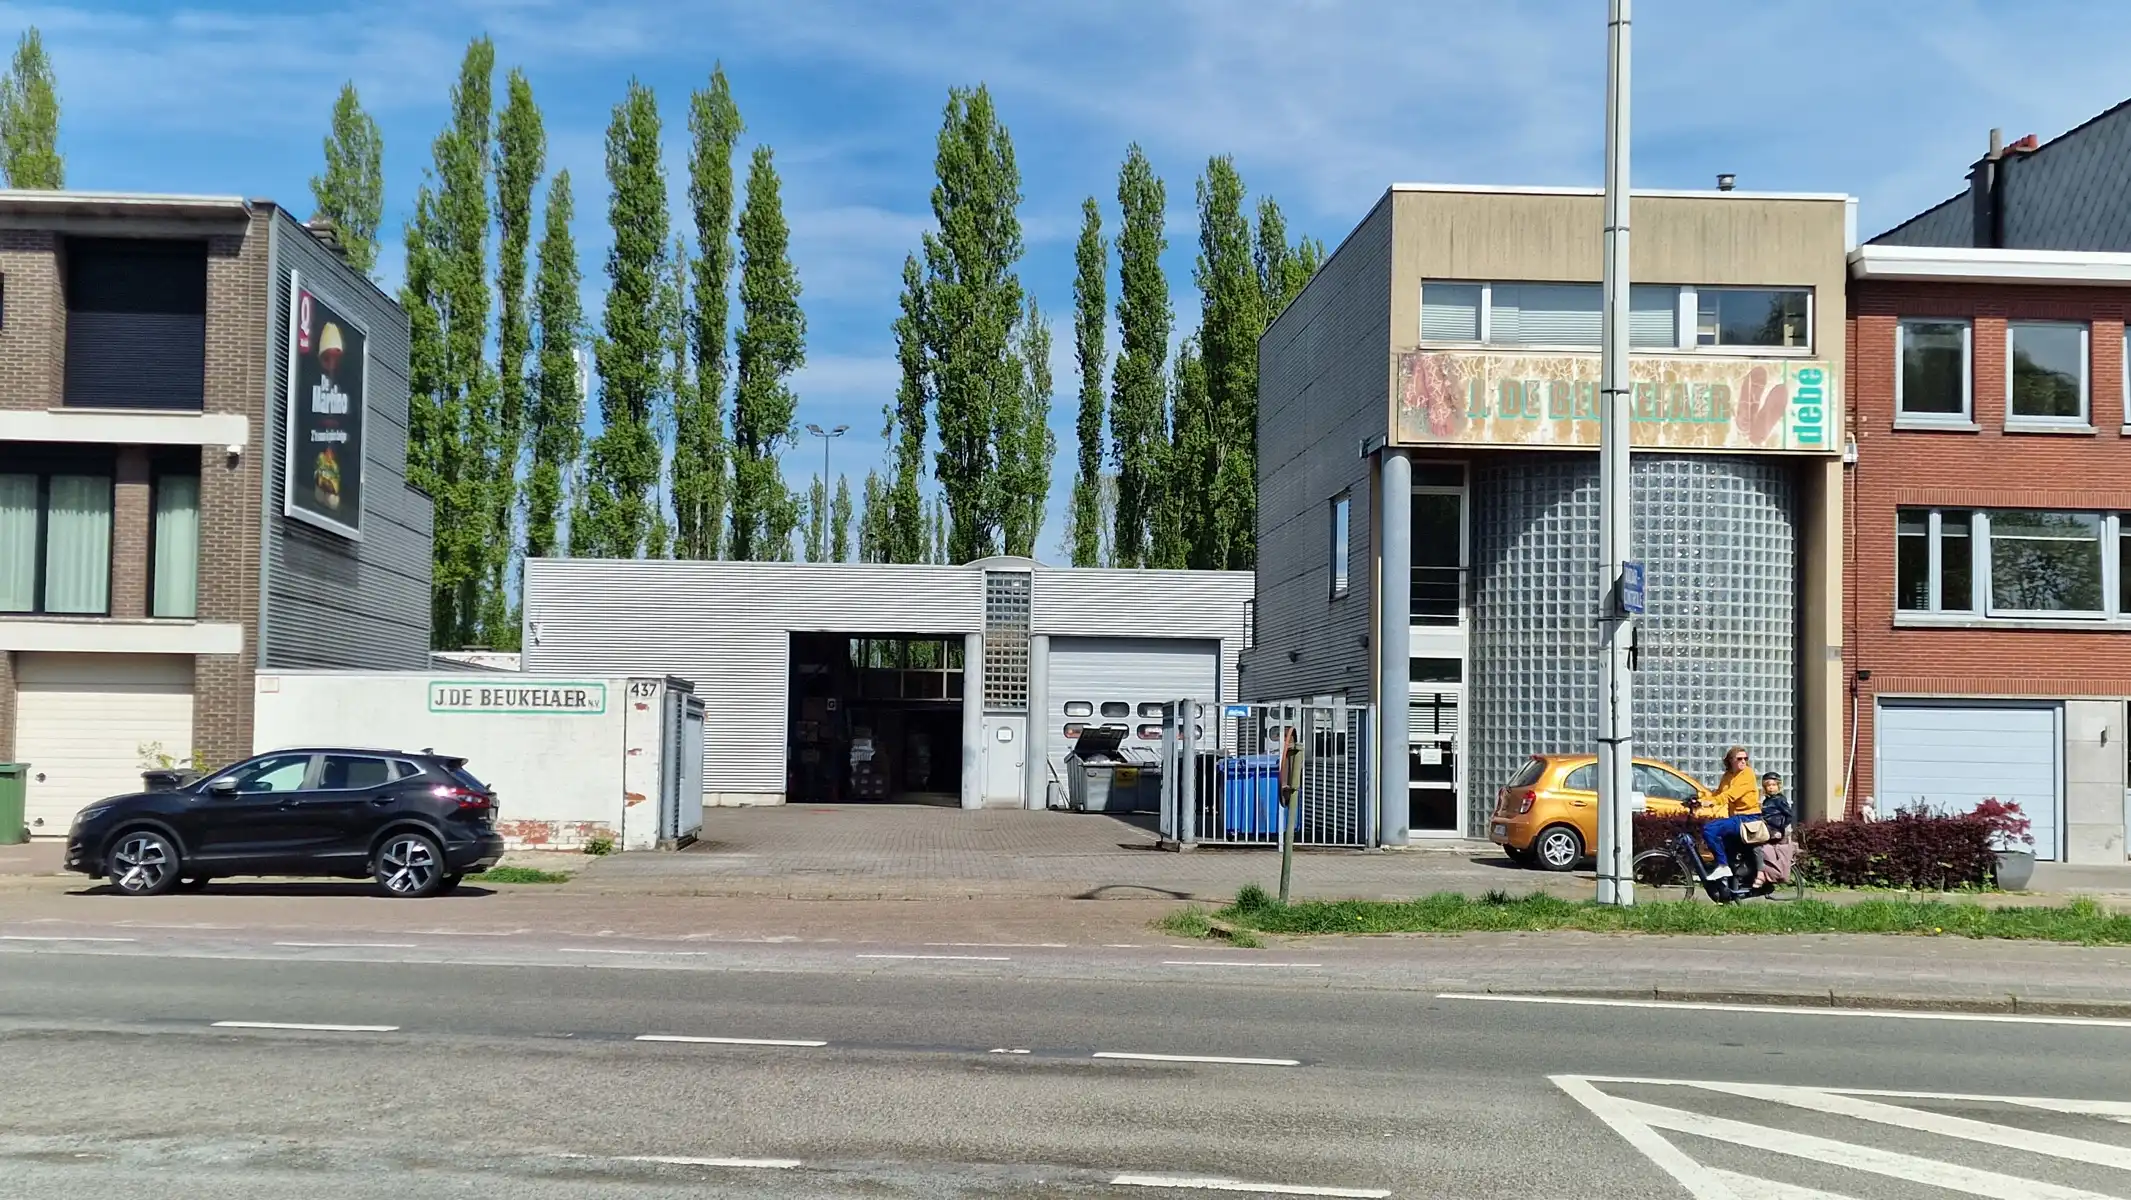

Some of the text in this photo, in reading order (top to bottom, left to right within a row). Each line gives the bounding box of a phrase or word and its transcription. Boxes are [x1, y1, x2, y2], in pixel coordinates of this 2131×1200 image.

[312, 385, 348, 414] Martino
[1499, 380, 1541, 418] DE
[479, 689, 586, 707] BEUKELAER
[630, 683, 657, 697] 437
